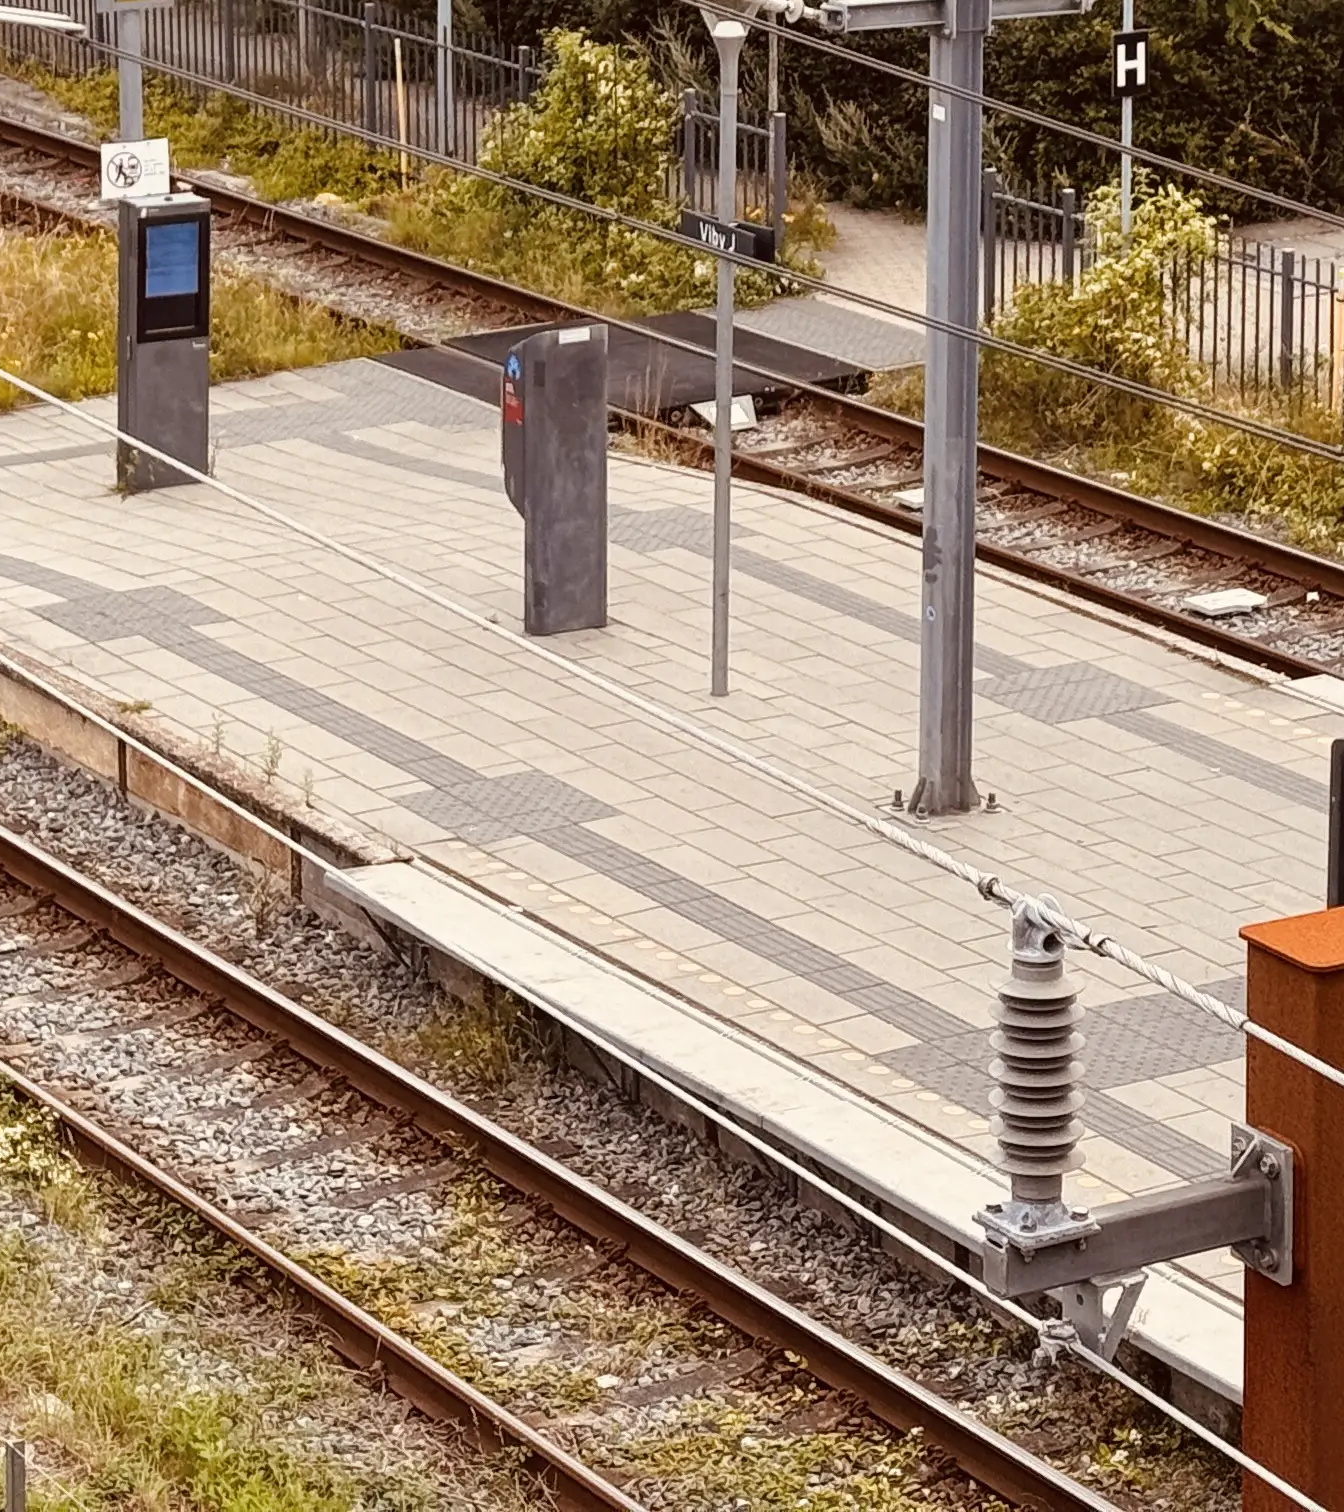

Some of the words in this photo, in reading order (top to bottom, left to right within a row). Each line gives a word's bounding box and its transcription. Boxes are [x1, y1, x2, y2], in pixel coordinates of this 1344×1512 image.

[1116, 41, 1146, 88] H
[699, 220, 726, 250] Viby
[727, 232, 736, 252] J
